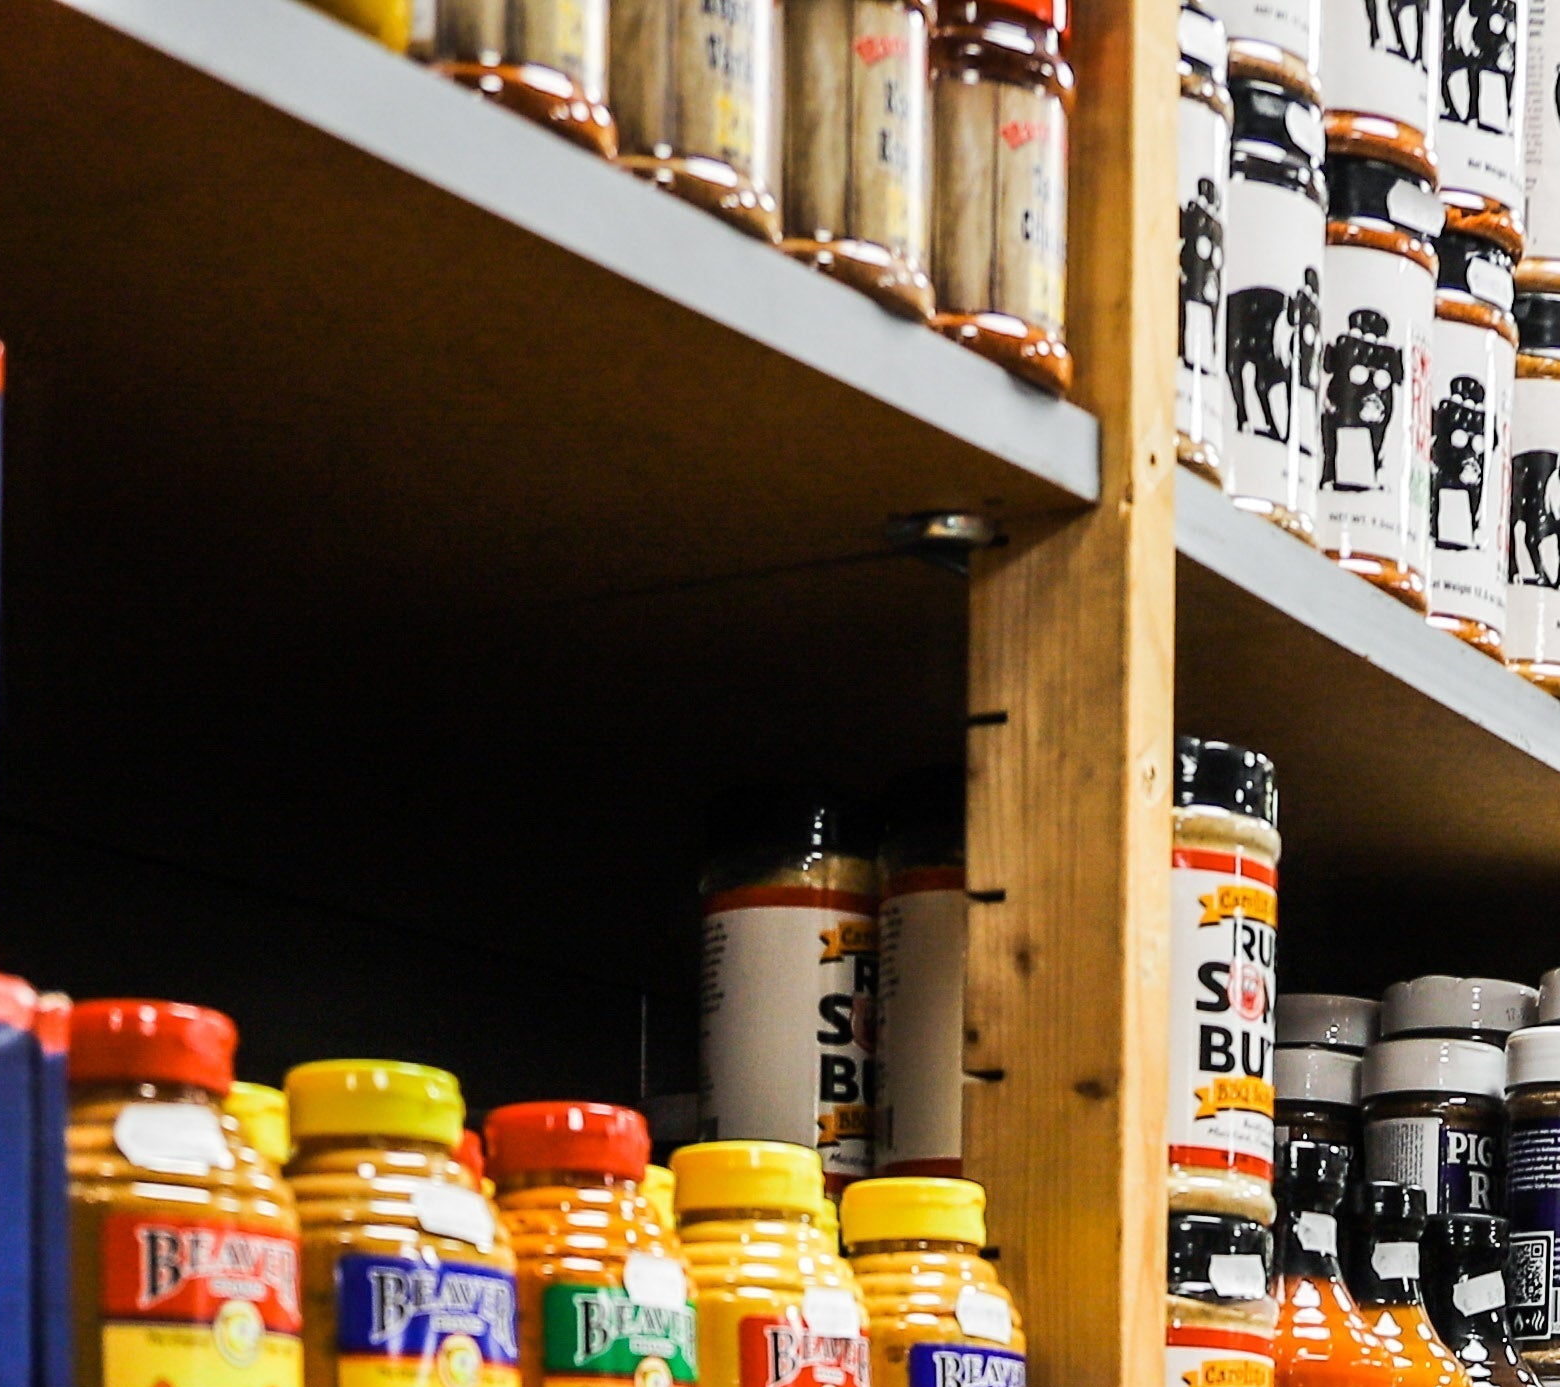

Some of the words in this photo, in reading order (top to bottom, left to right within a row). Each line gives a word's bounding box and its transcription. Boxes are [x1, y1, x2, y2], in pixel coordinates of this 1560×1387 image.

[136, 1225, 302, 1322] BEAVER
[369, 1268, 519, 1356] BEAVER
[574, 1291, 697, 1378] BEAVER
